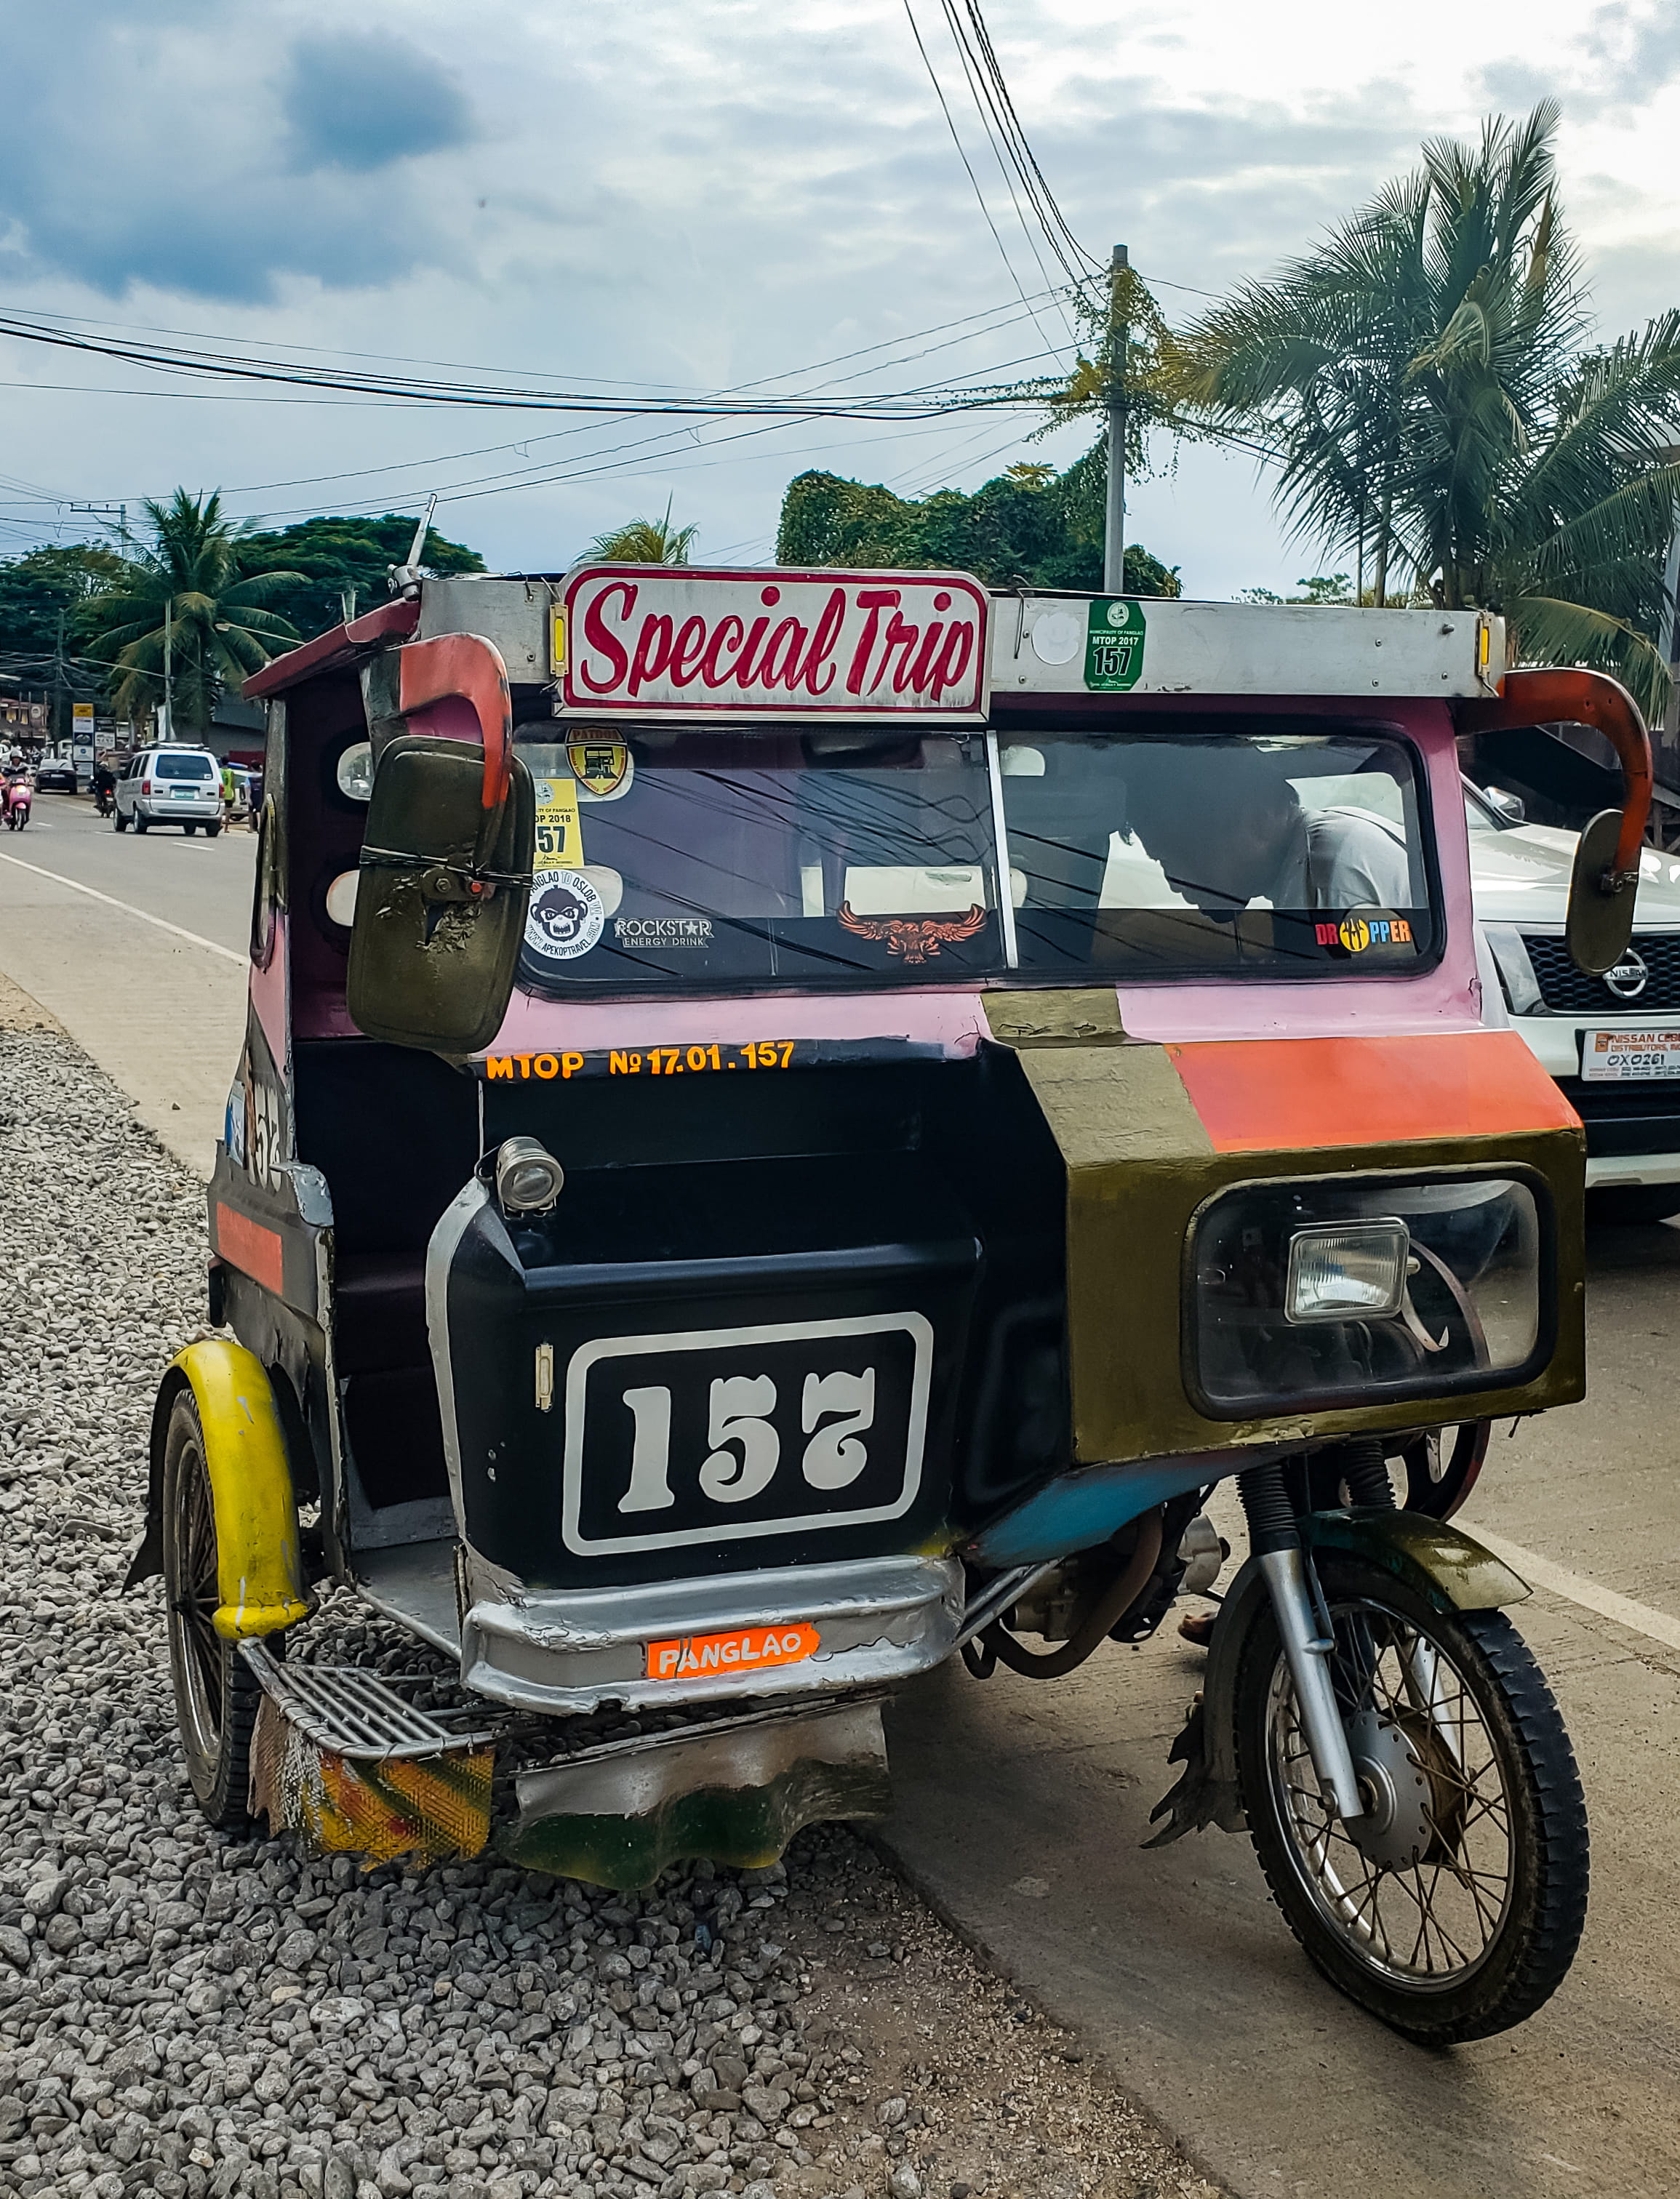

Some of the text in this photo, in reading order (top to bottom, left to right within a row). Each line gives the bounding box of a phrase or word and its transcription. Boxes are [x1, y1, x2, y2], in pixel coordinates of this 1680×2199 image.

[581, 582, 974, 701] Special Trip
[1092, 636, 1139, 646] MTOP 2017
[1093, 646, 1132, 676] 157
[537, 826, 565, 853] 57
[561, 871, 572, 884] TO
[572, 877, 596, 902] OSLOB
[624, 937, 704, 946] ENERGY DRINK
[1612, 1034, 1655, 1043] NISSAN
[487, 1052, 584, 1080] MTOP
[617, 1367, 875, 1513] 157
[659, 1633, 801, 1674] PANGLAO
